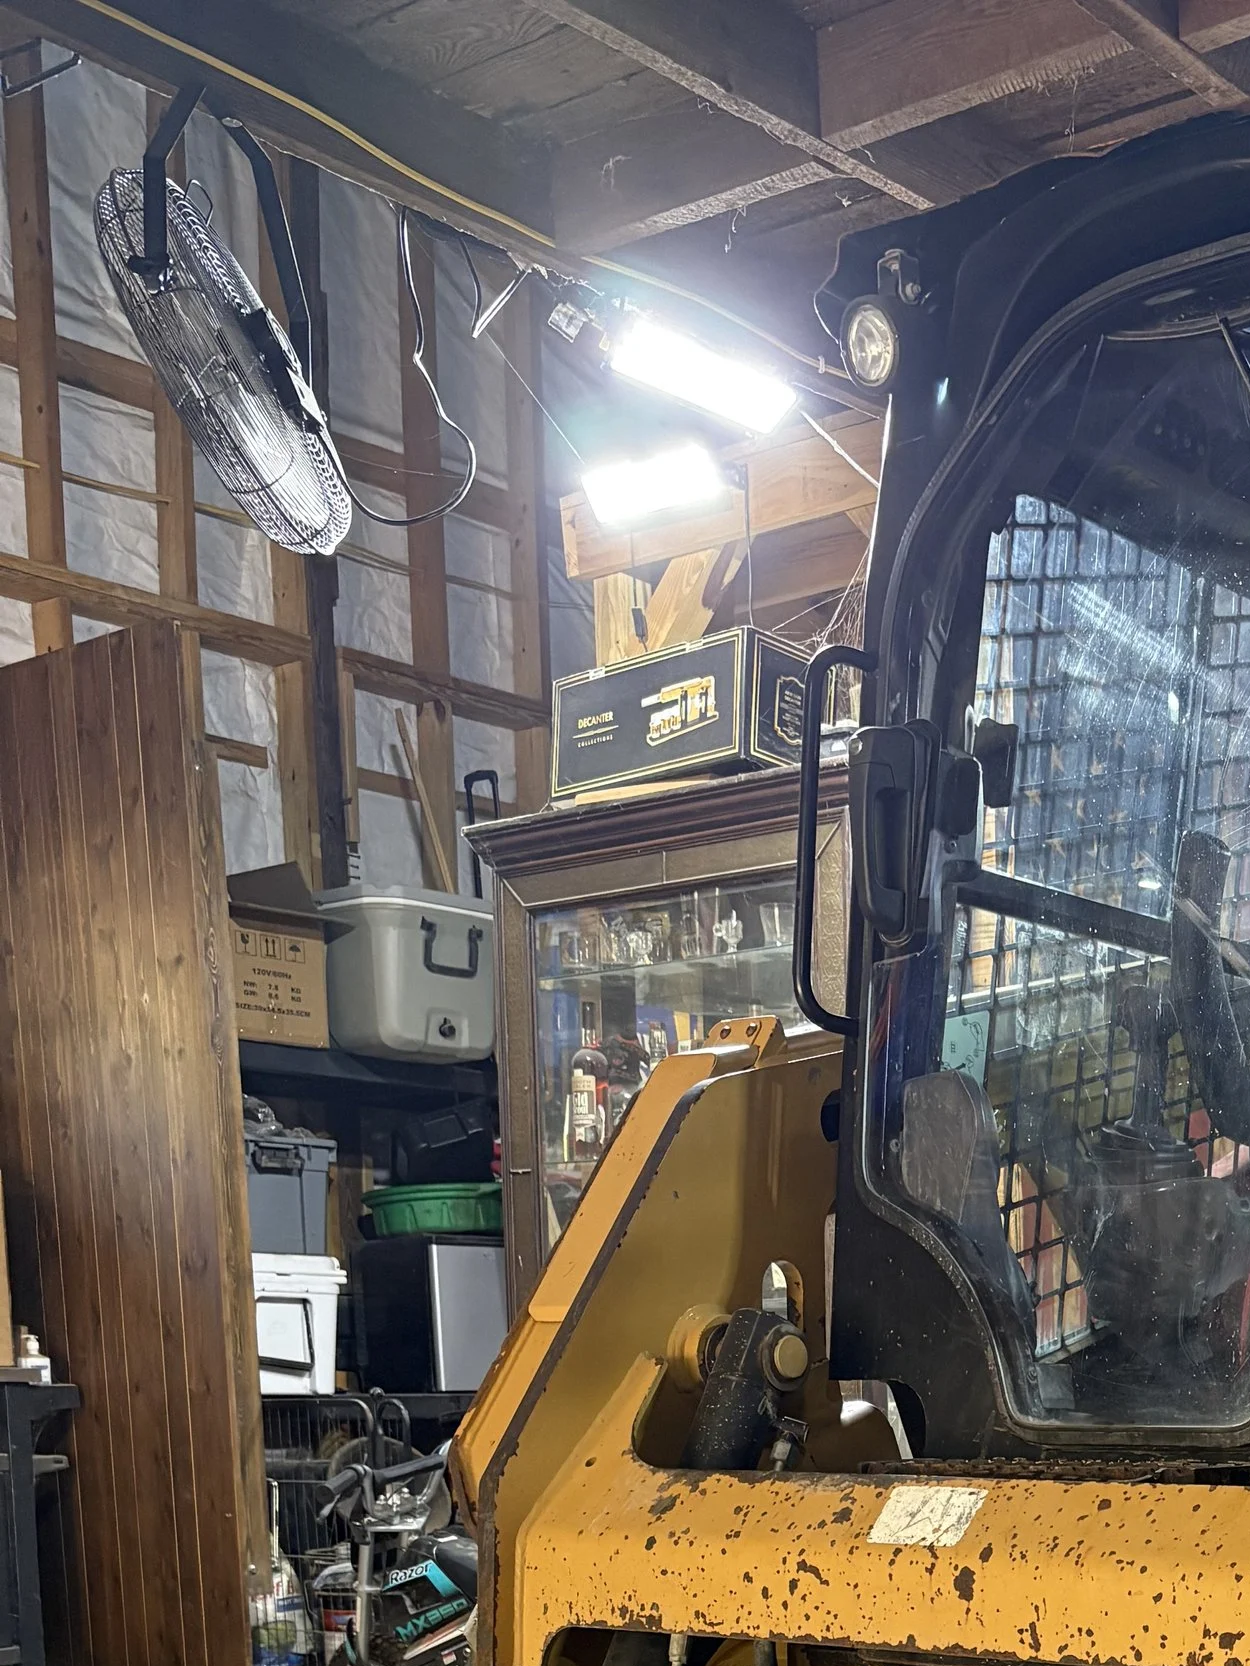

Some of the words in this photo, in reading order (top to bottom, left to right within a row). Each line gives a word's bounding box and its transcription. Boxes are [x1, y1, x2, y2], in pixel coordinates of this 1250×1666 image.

[578, 711, 613, 729] DECANTER
[390, 1562, 431, 1585] Razor
[394, 1599, 469, 1642] MX350
